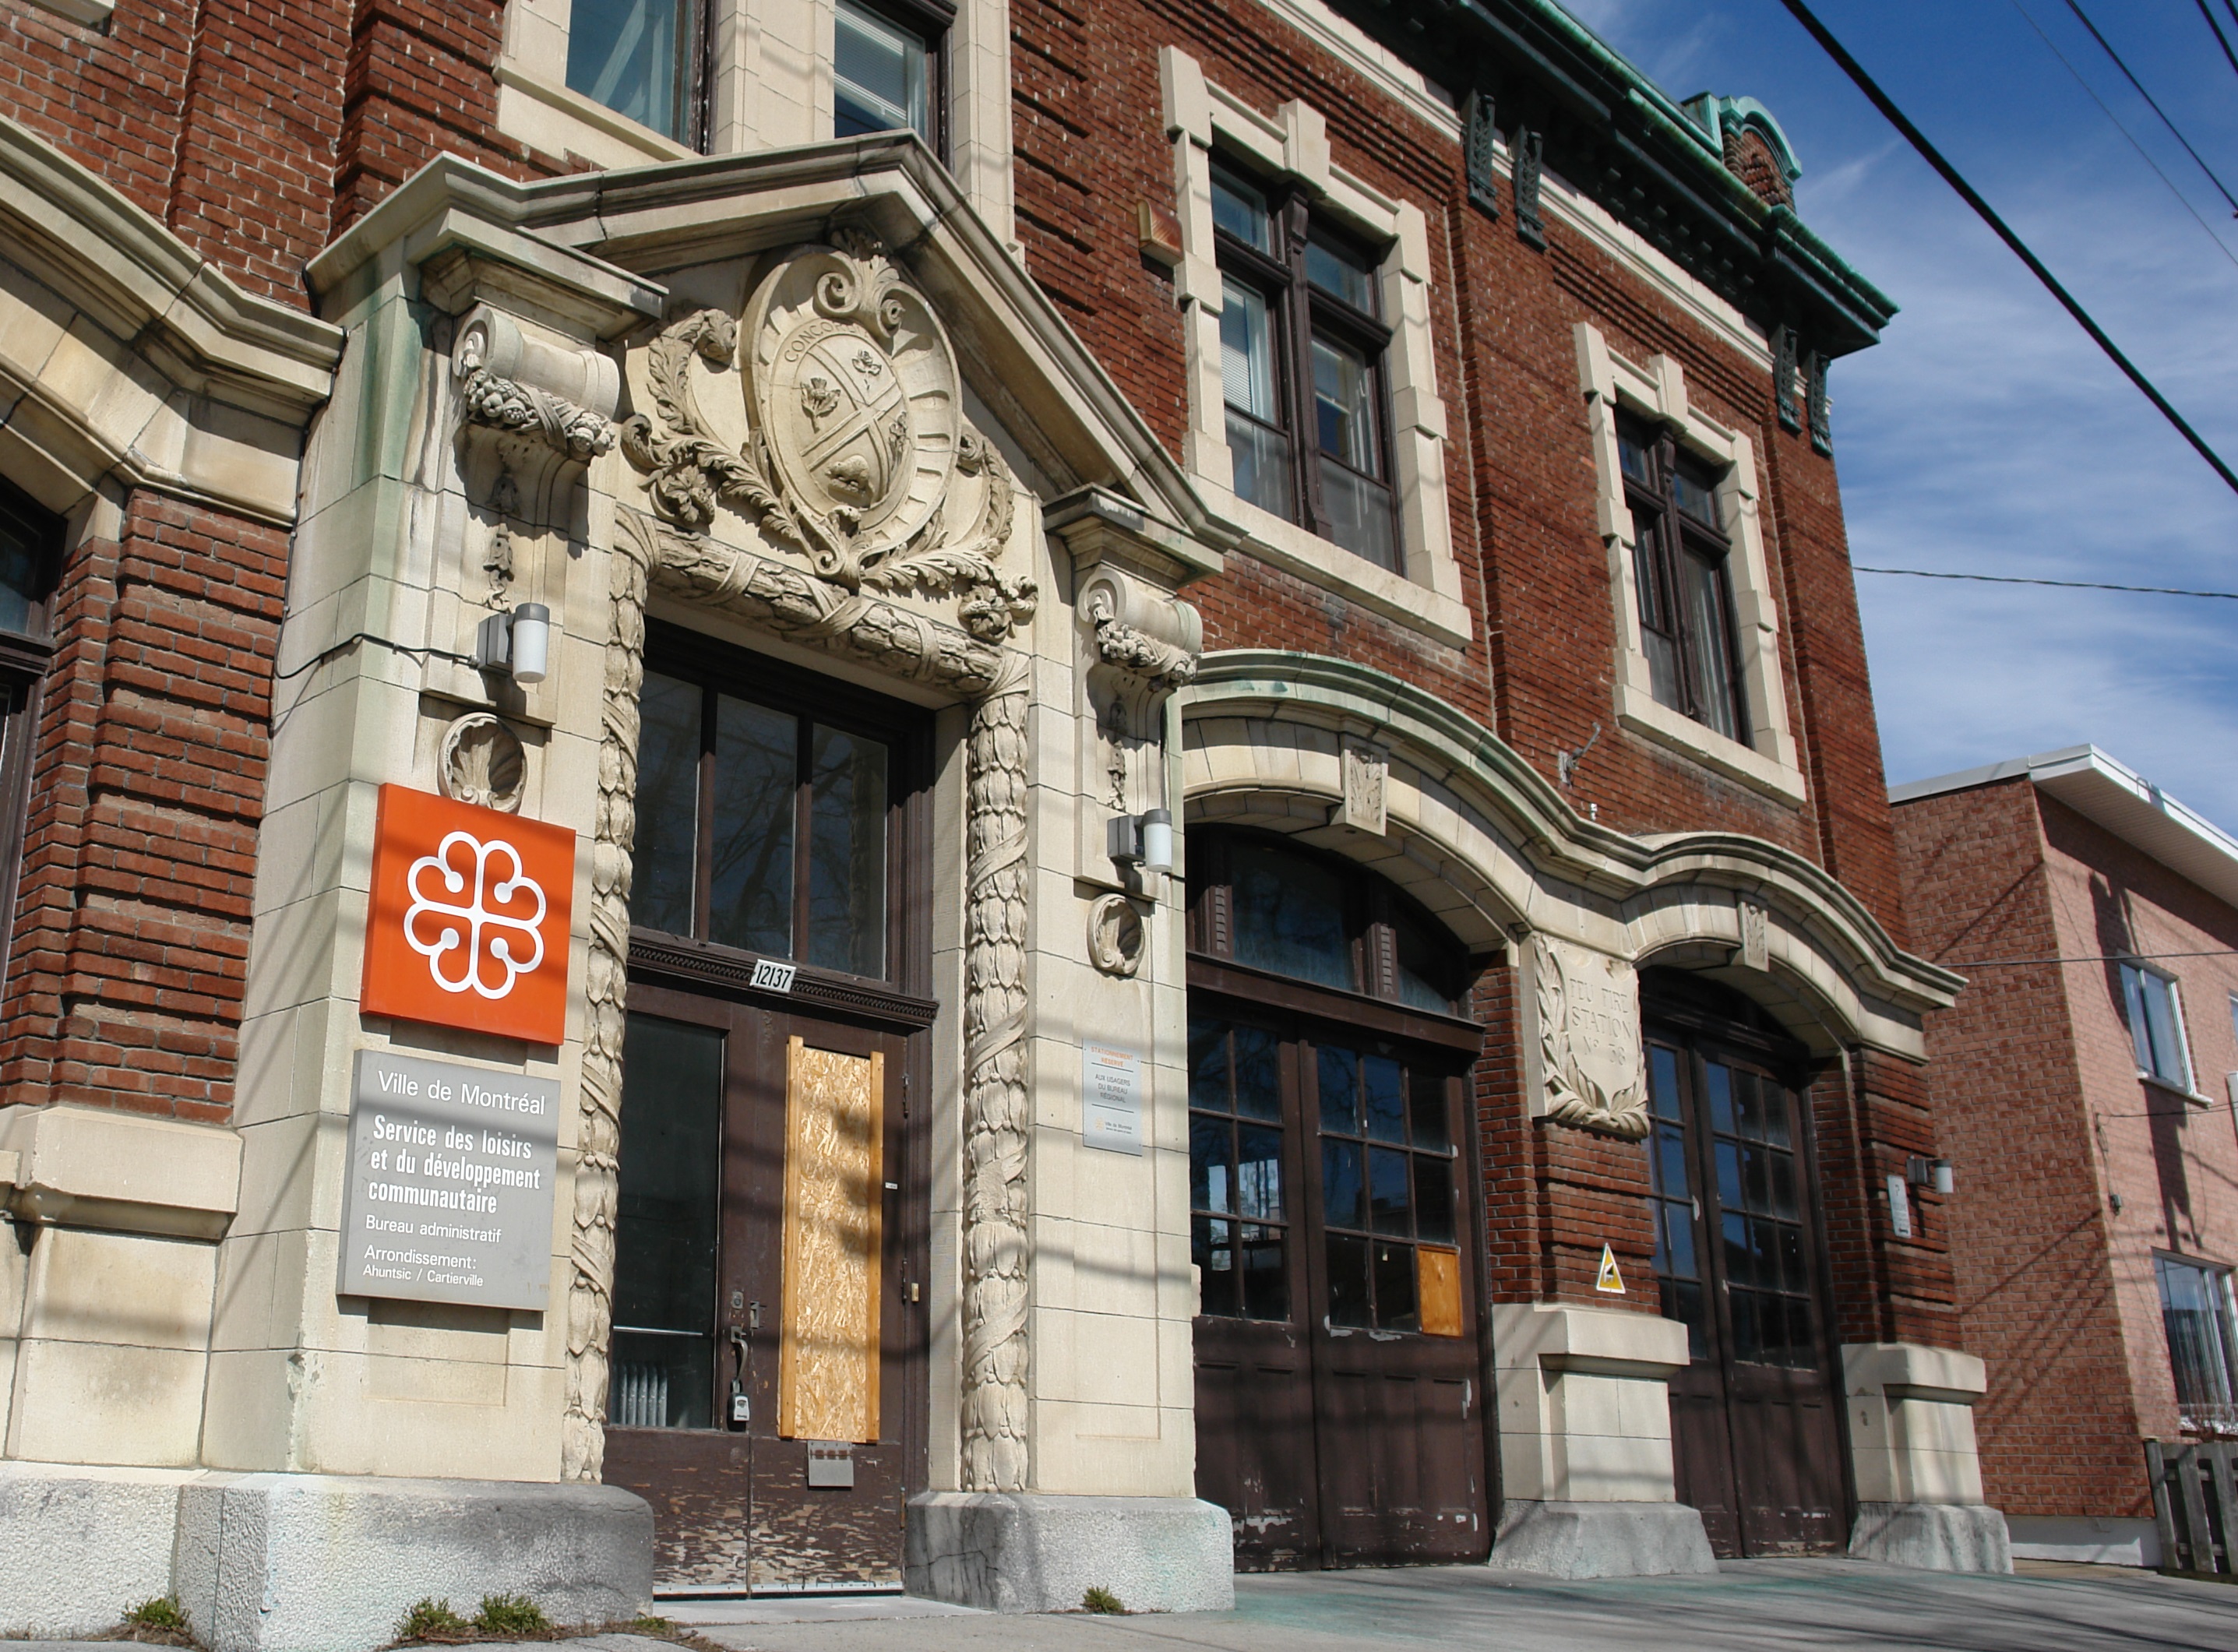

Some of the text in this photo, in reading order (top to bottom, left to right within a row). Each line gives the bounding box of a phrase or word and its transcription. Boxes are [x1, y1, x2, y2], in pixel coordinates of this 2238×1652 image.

[756, 964, 791, 989] 12137
[1572, 1006, 1632, 1038] STATION
[378, 1070, 545, 1115] Ville de Montréal
[1107, 1084, 1128, 1094] BUREAU
[373, 1114, 532, 1159] Service des loisirs
[371, 1148, 541, 1189] et du développement
[368, 1182, 497, 1213] communautaire
[365, 1214, 502, 1243] Bureau administratif
[364, 1244, 477, 1270] Arrondissement:
[362, 1263, 484, 1287] Ahuntsic / Cartierville
